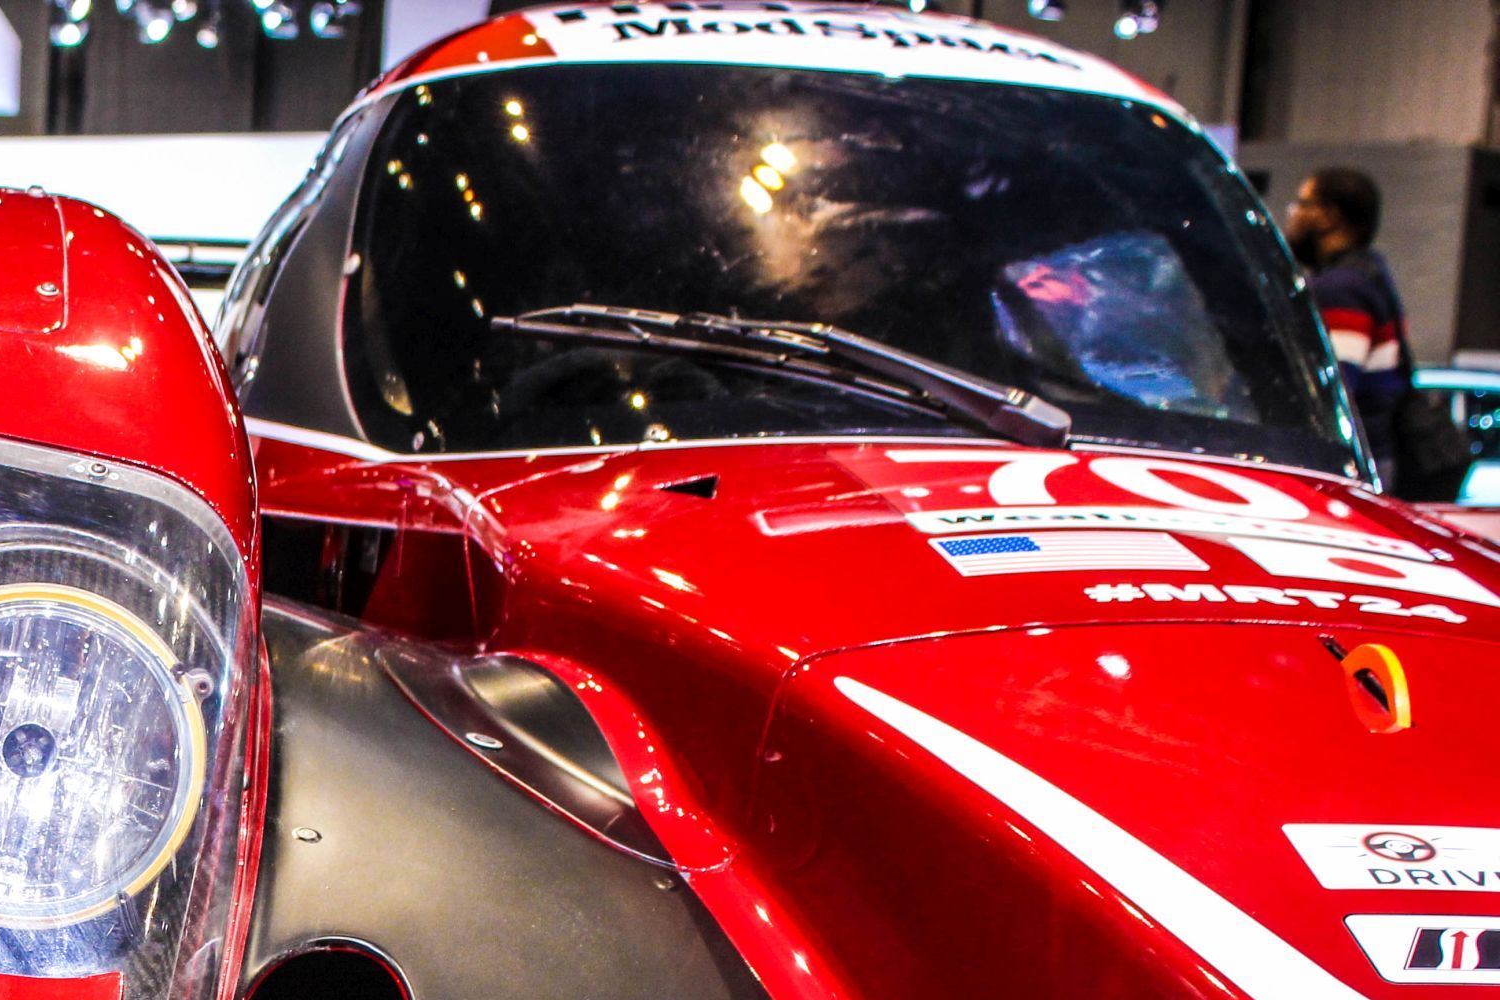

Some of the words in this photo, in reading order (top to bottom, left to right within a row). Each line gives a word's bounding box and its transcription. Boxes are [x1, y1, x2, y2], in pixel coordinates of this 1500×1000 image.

[884, 449, 1310, 520] 70
[1083, 582, 1468, 625] #MRT24
[1367, 867, 1500, 887] DRIV
